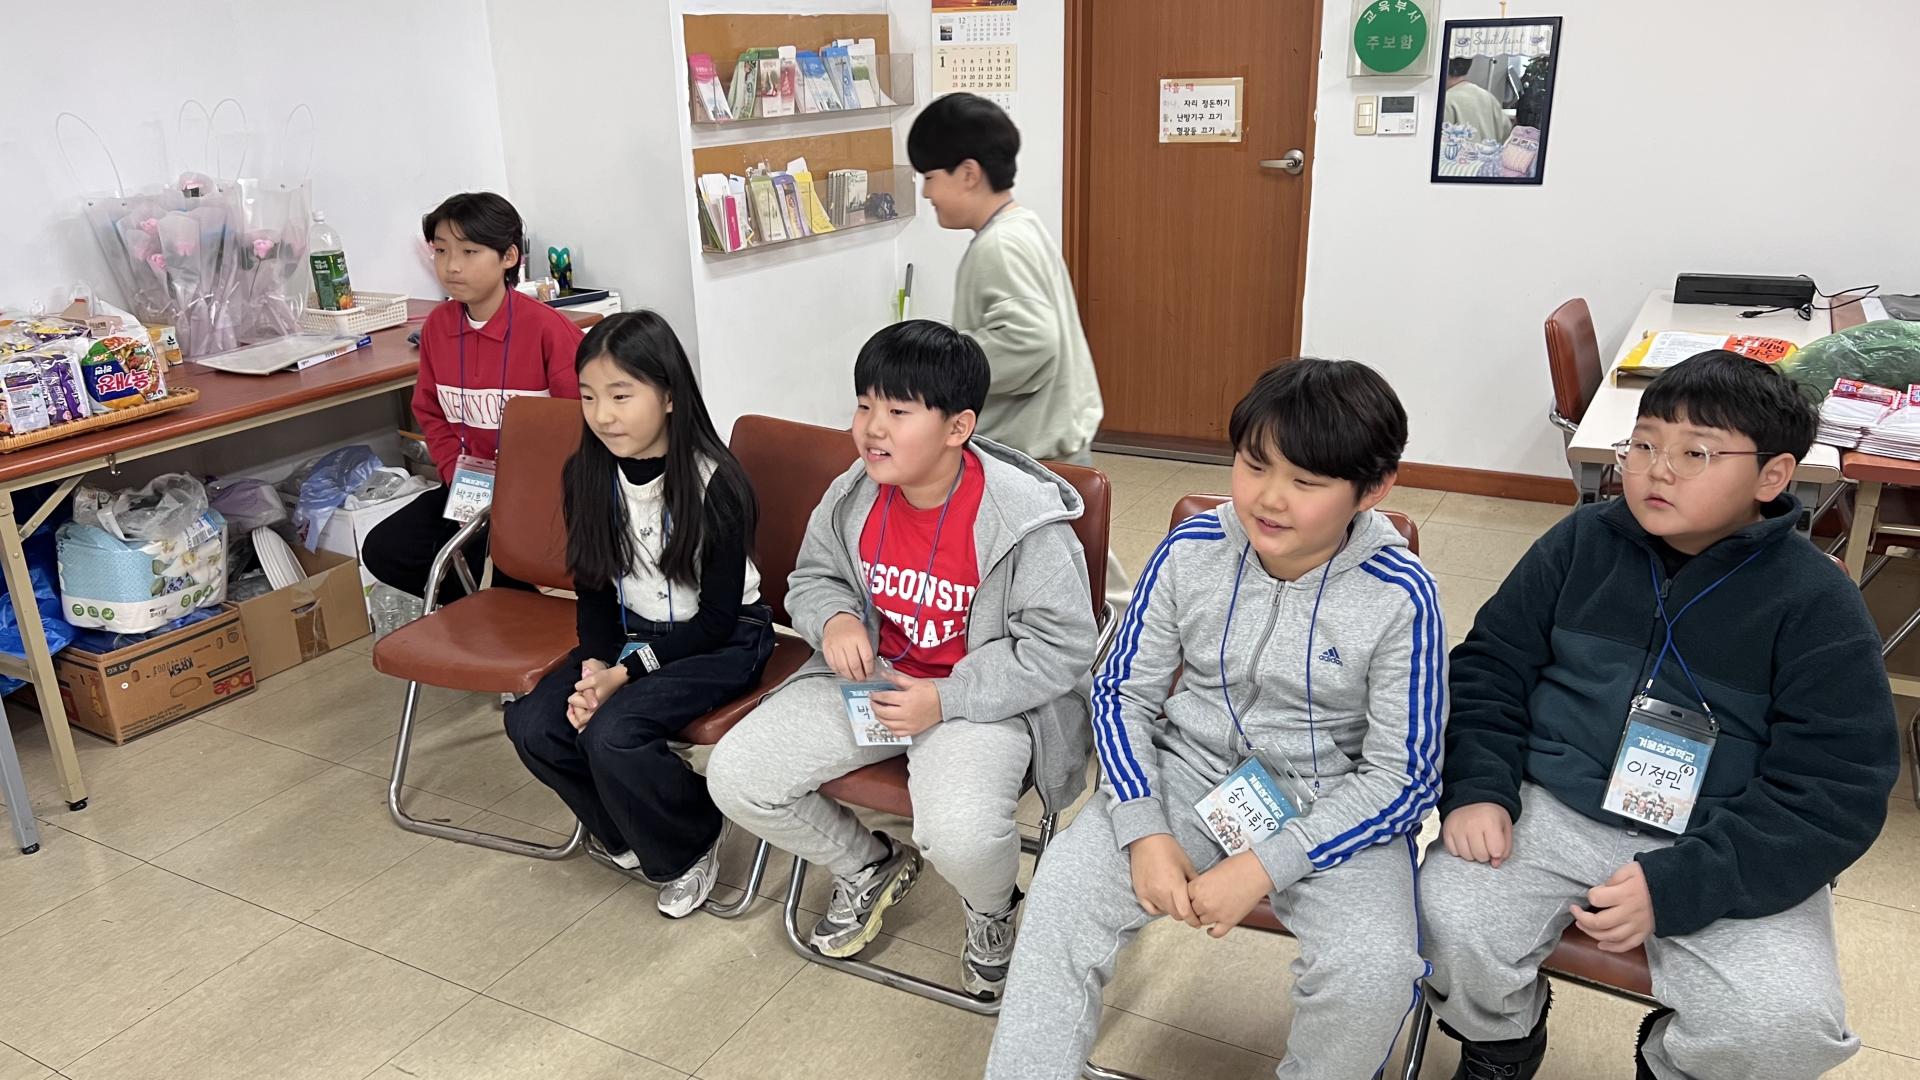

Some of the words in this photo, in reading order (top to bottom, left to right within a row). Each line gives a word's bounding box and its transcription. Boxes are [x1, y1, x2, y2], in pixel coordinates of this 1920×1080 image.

[1363, 0, 1422, 24] 교육부서
[1366, 34, 1414, 51] 주보함
[940, 56, 945, 68] 1
[1184, 99, 1198, 107] 자리
[1201, 99, 1230, 109] 정돈하기
[1176, 113, 1205, 123] 난방기구
[1208, 113, 1223, 121] 끄기
[1176, 127, 1197, 136] 형광등
[1201, 127, 1215, 135] 끄기
[94, 365, 113, 376] 라면
[97, 369, 149, 395] 육개장
[1318, 654, 1344, 667] adidas
[1639, 736, 1695, 763] 겨울성경학교
[1627, 760, 1683, 791] 이정민
[1228, 786, 1263, 832] 송서휘
